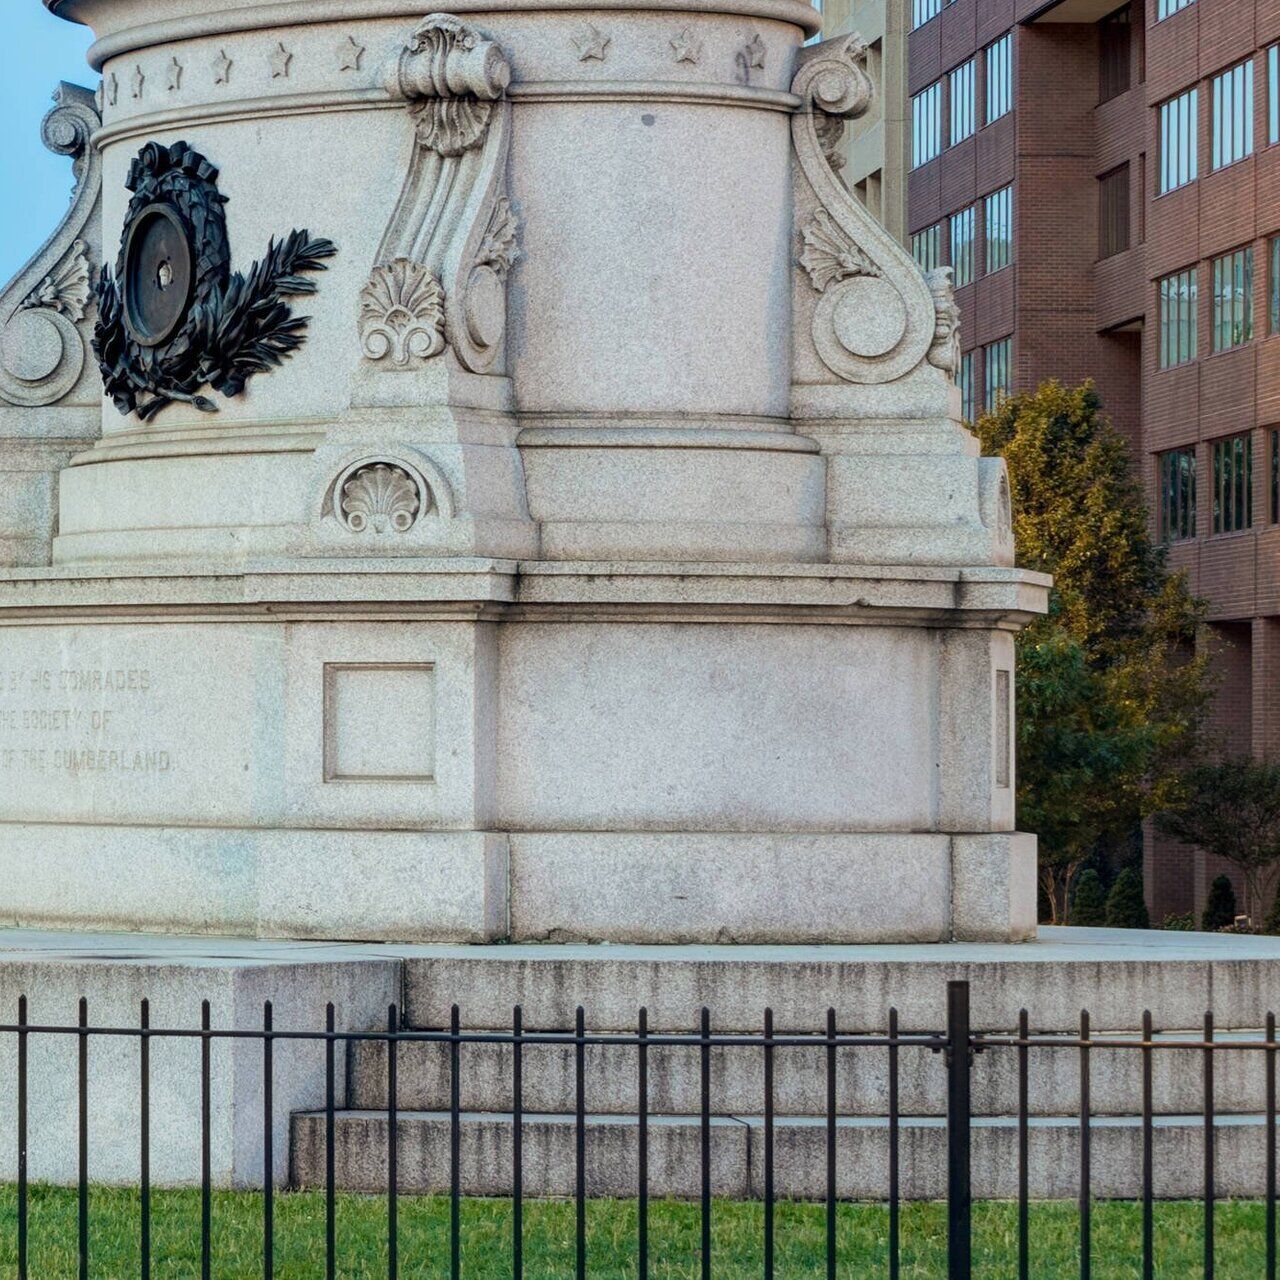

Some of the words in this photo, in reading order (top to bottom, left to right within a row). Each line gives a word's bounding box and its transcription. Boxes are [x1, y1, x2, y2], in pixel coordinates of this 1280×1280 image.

[59, 669, 151, 691] COMRADES
[22, 708, 83, 731] SOCIETY
[91, 710, 113, 731] OF
